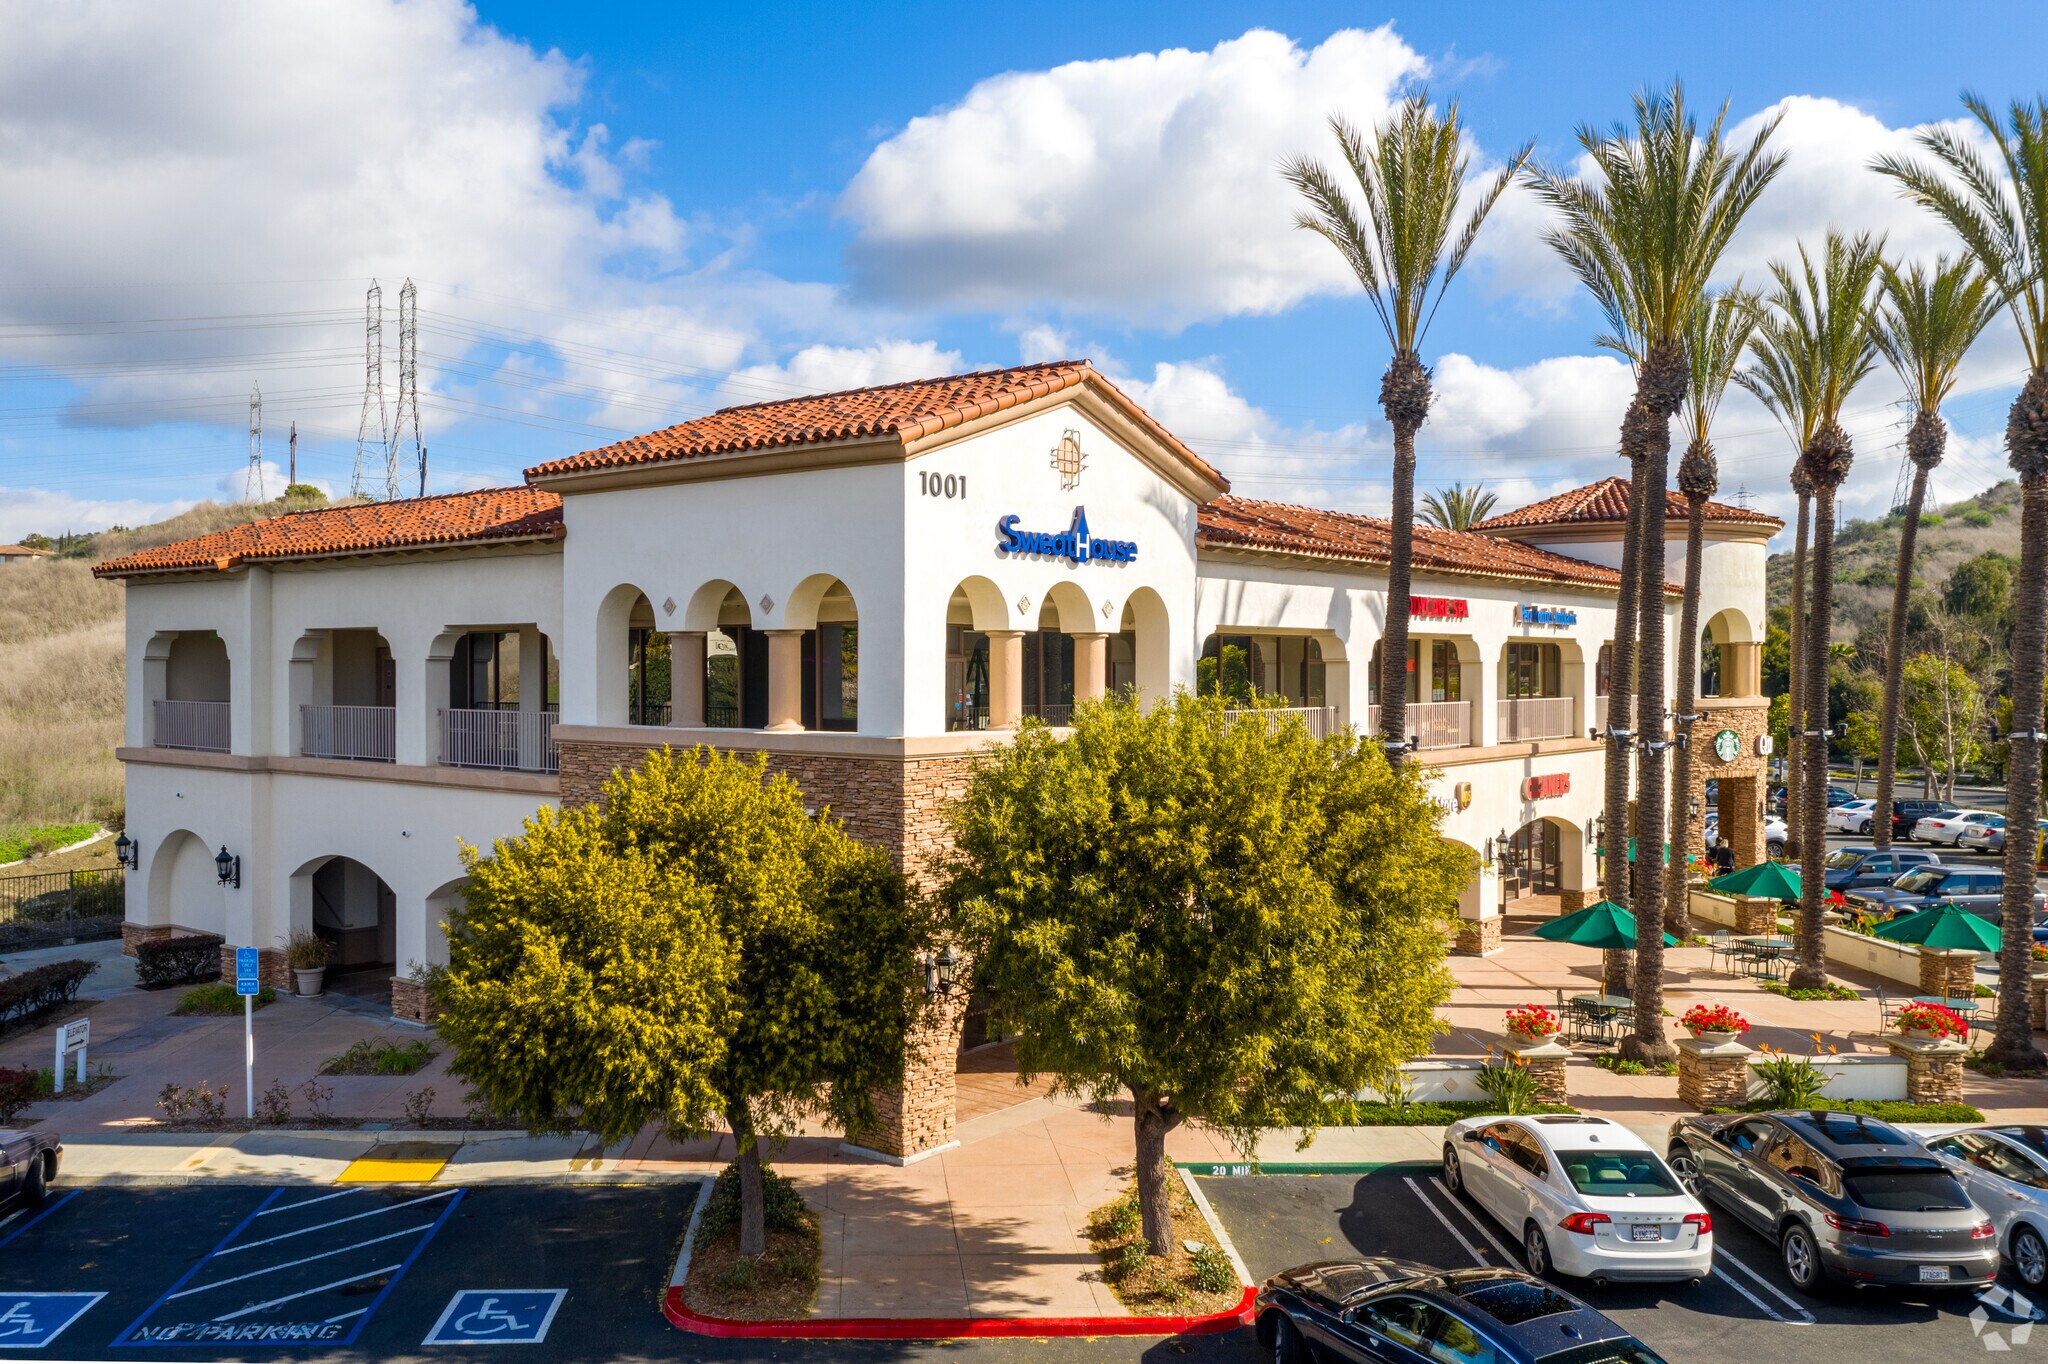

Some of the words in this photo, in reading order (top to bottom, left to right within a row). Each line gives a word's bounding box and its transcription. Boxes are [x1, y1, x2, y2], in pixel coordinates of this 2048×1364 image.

[919, 470, 967, 500] 1001
[1452, 599, 1469, 618] SPA
[1212, 1165, 1226, 1175] 20
[194, 1324, 343, 1341] PARKING
